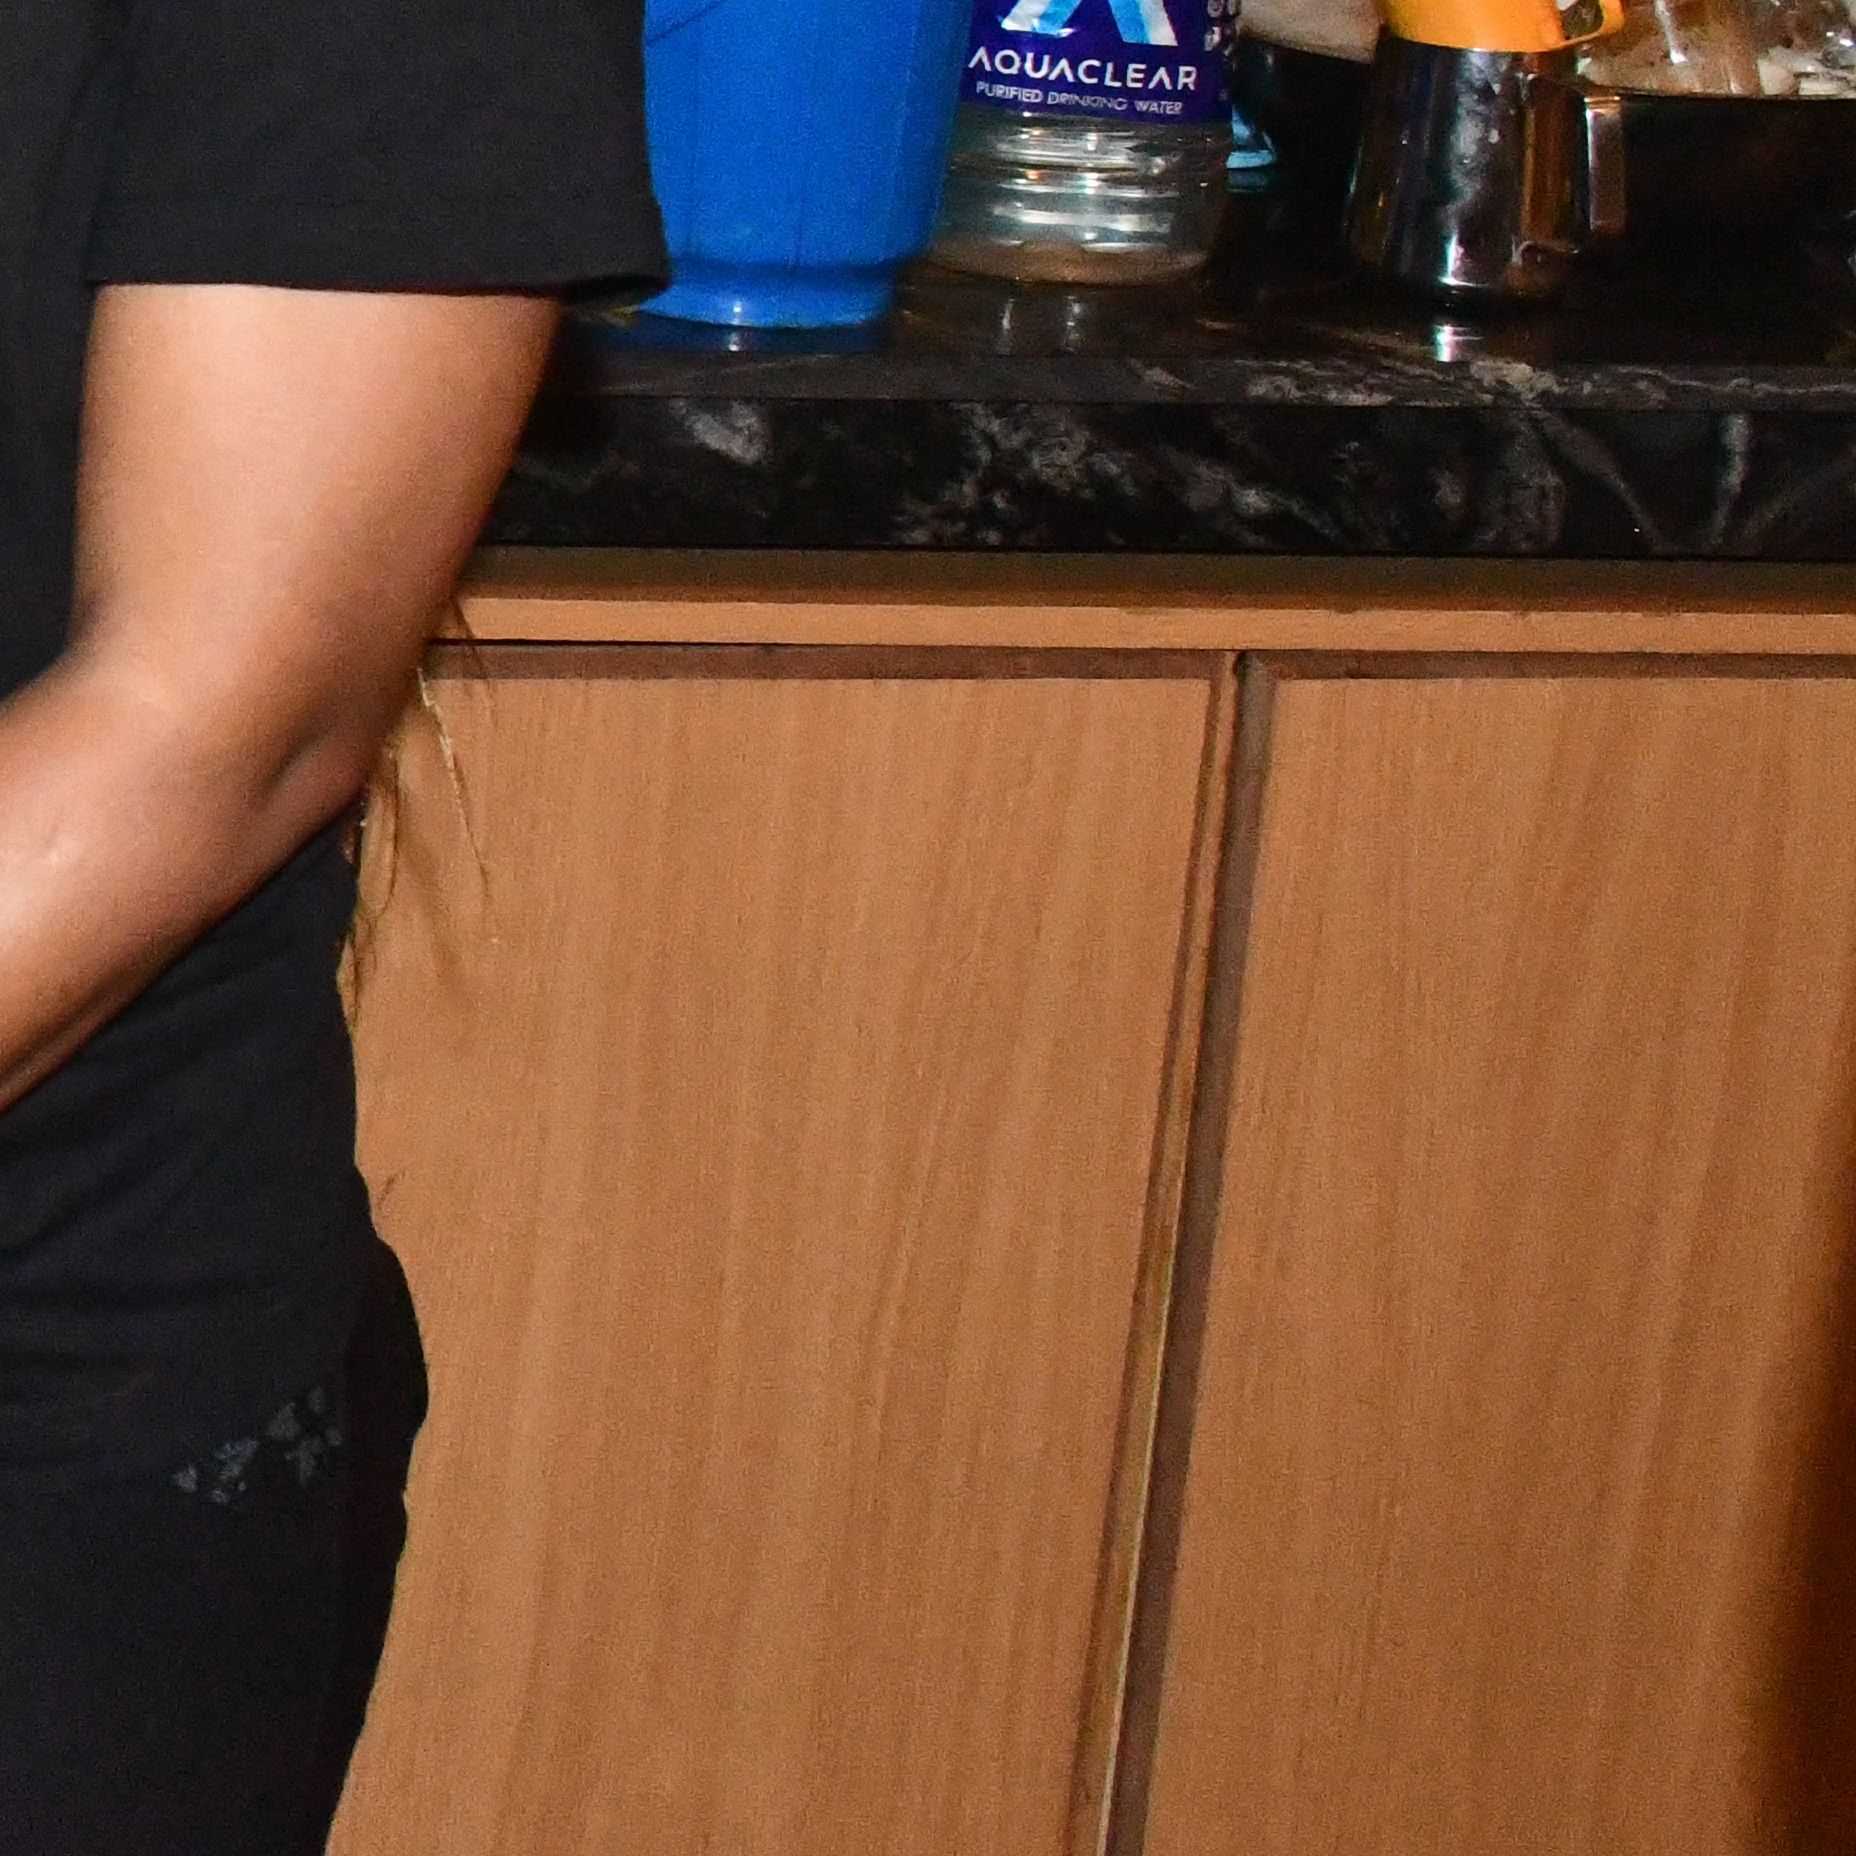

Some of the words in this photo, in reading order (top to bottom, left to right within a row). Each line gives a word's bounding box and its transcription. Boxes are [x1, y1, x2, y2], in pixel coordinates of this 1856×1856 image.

[968, 45, 1199, 91] AQUACLEAR
[975, 80, 1043, 104] PURIFIED
[1046, 91, 1129, 111] DRINKING
[1134, 100, 1184, 116] WATER
